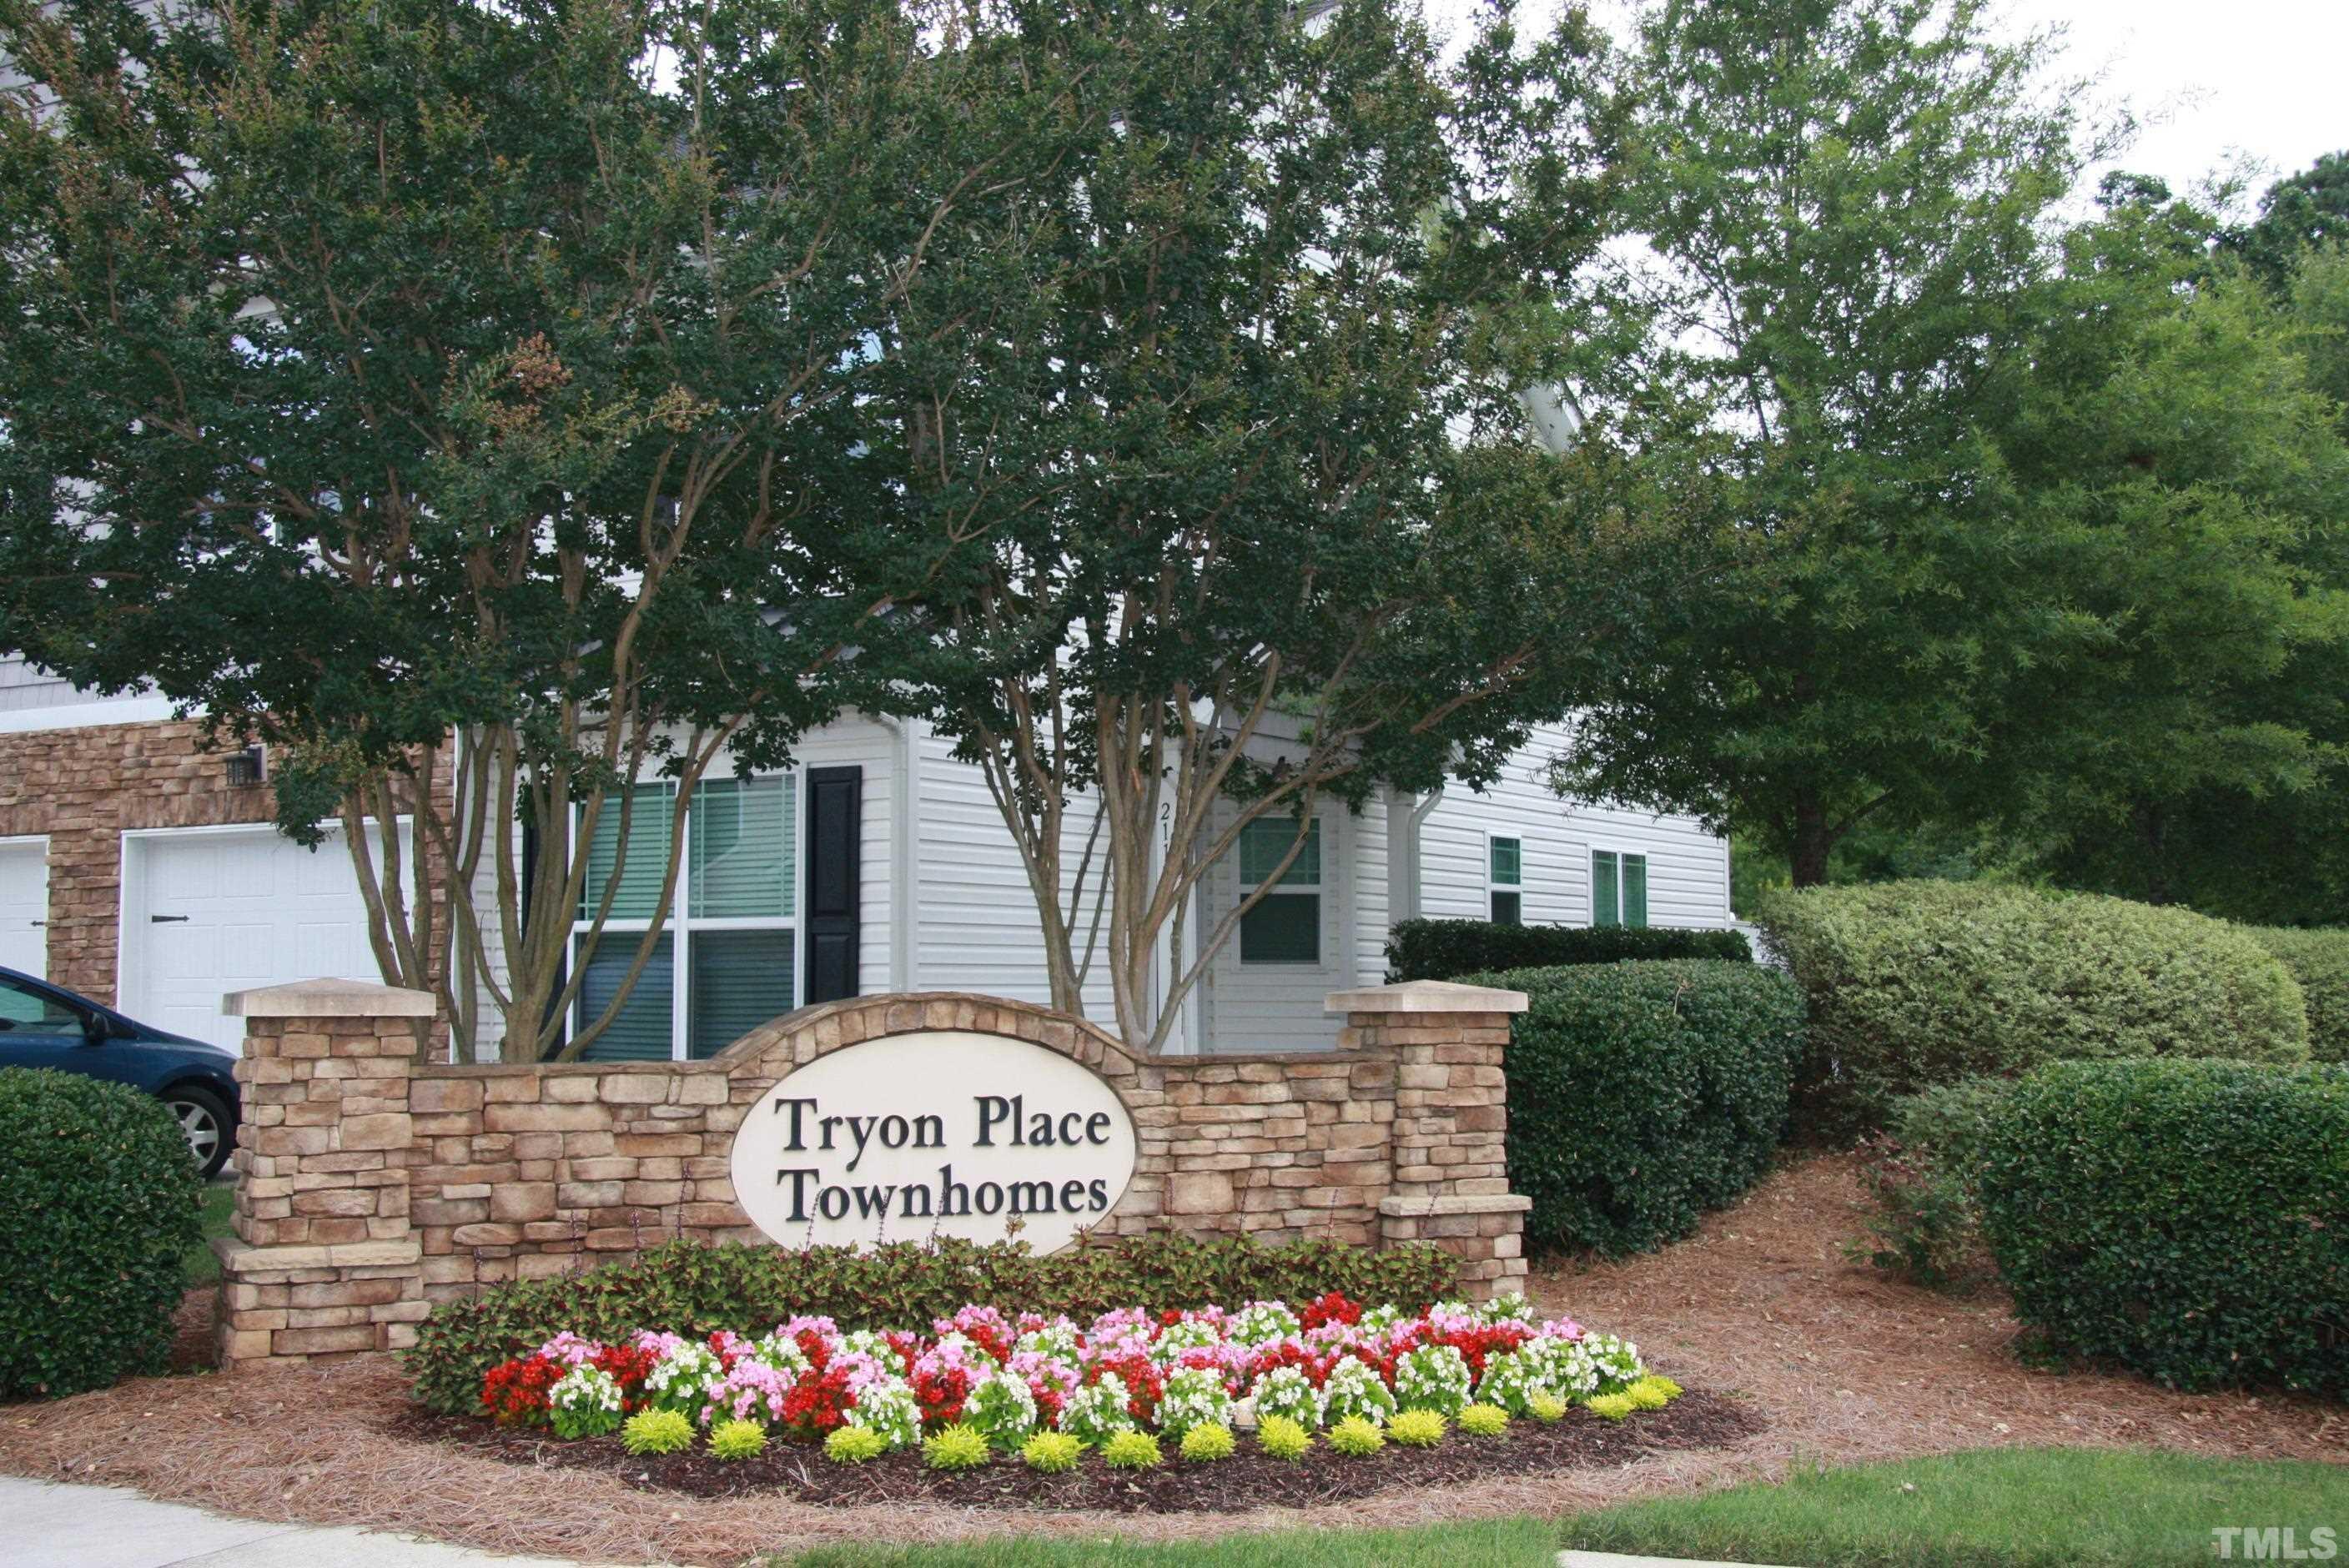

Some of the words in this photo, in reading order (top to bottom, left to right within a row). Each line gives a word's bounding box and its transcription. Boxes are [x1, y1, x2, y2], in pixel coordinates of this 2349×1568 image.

[774, 1098, 947, 1172] Tryon
[973, 1094, 1111, 1148] Place
[777, 1163, 1109, 1222] Townhomes
